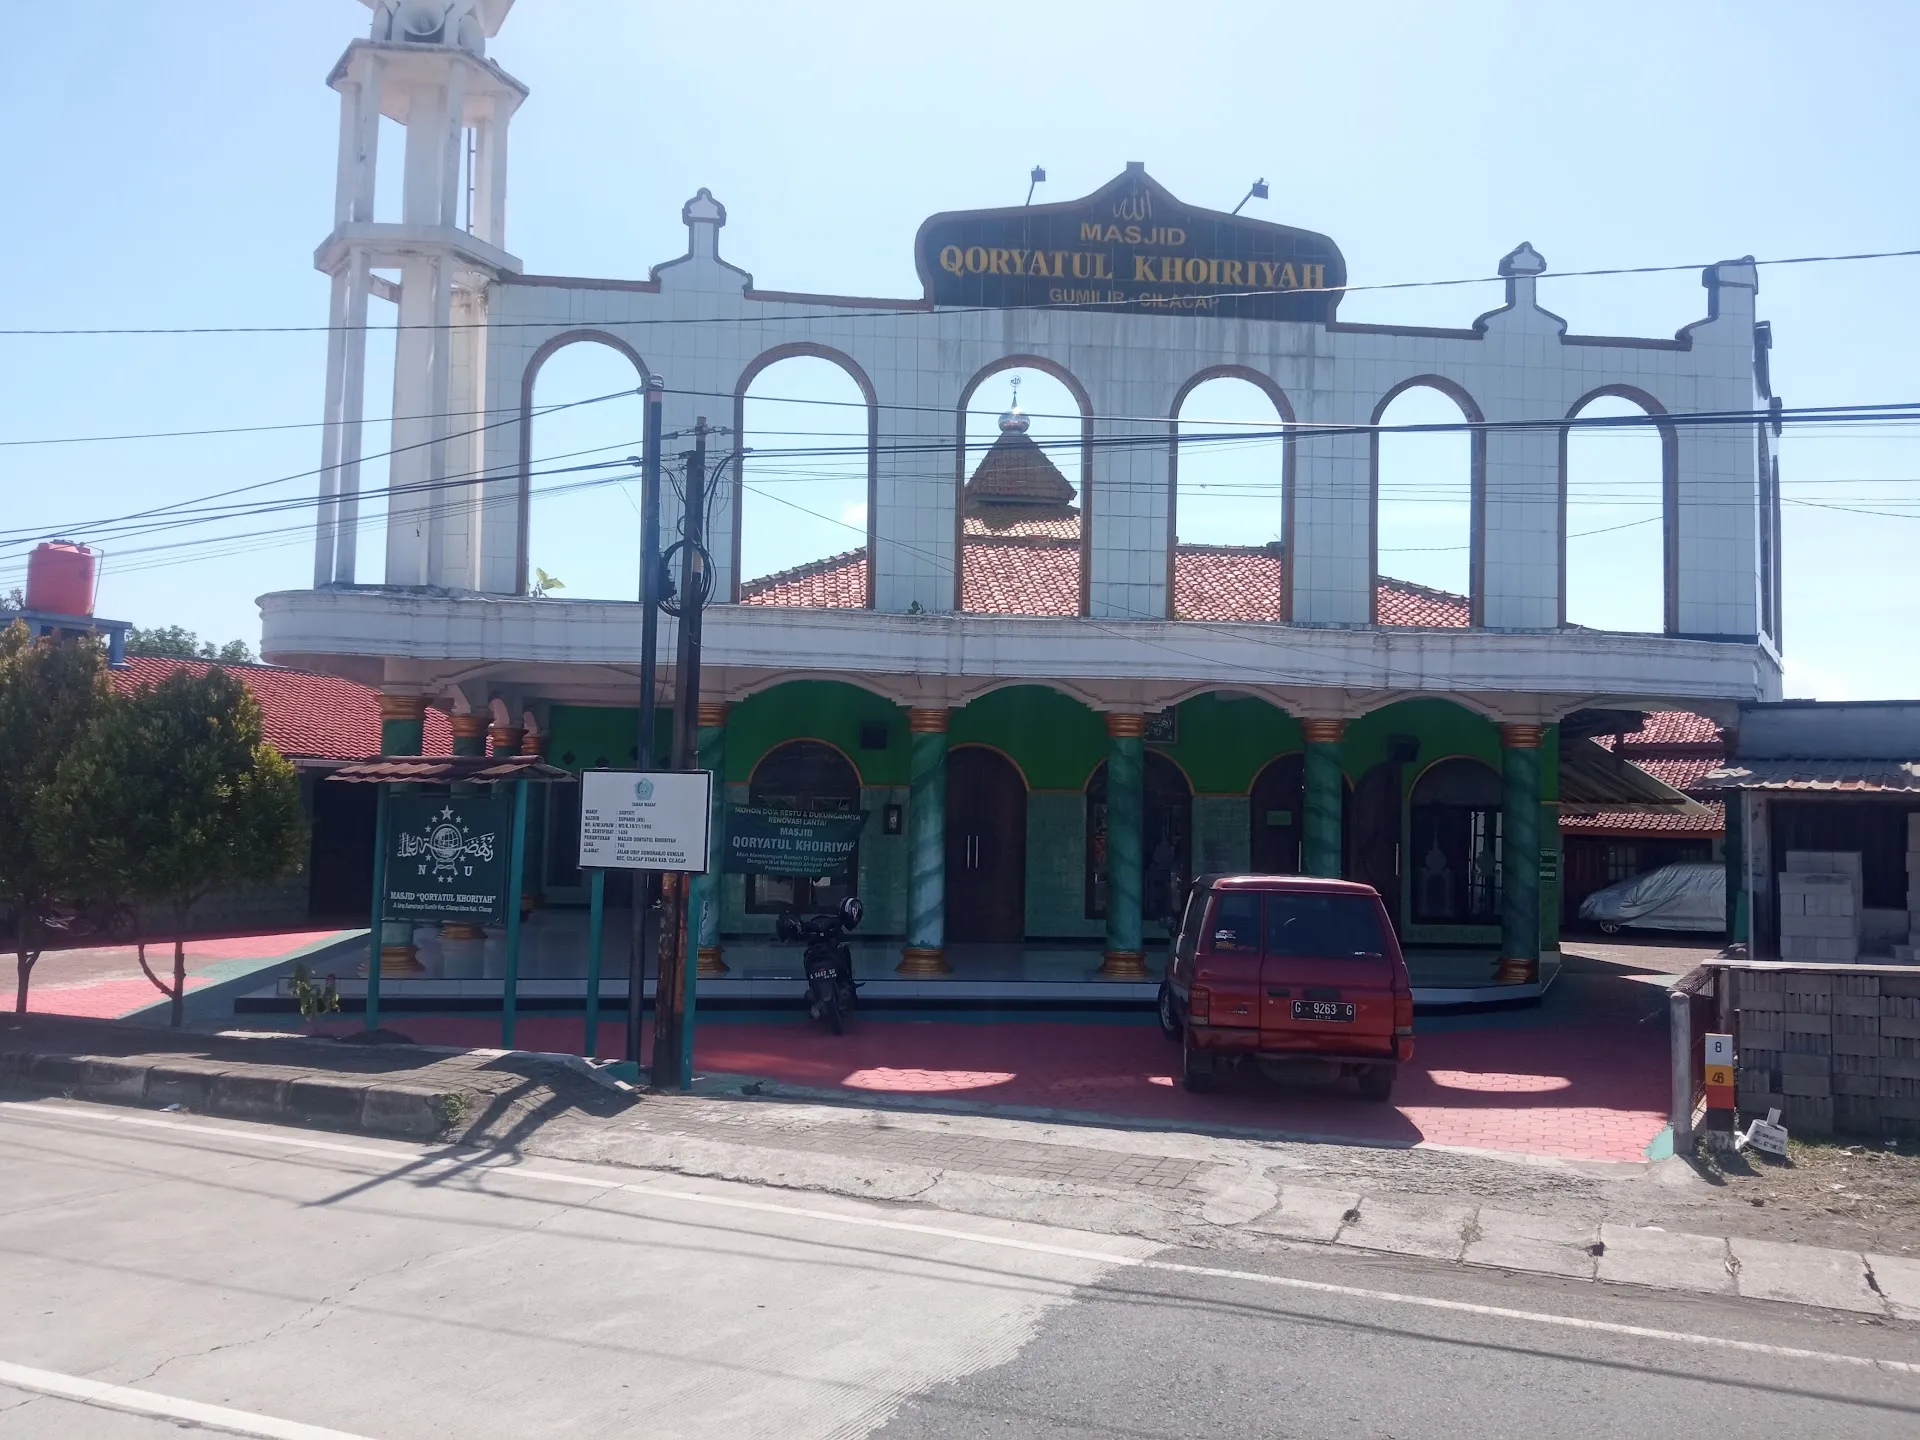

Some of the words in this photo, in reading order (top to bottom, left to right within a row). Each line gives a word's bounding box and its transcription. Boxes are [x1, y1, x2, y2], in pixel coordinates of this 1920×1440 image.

[1080, 223, 1186, 246] MASJID
[939, 245, 1114, 280] QORYATUL
[1134, 255, 1327, 289] KHOIRIYAH
[1050, 288, 1125, 304] GUMILIR
[1139, 292, 1220, 309] CILACAP
[735, 807, 761, 815] MOHON
[763, 808, 778, 816] DO'A
[780, 809, 802, 817] RESTU
[809, 811, 861, 821] DUKUNGANNYA
[768, 816, 802, 825] RENOVASI
[803, 818, 827, 827] LANTAI
[780, 827, 813, 837] MASJID
[732, 836, 792, 850] QORYATUL
[418, 865, 427, 875] N
[464, 866, 473, 876] U
[391, 891, 415, 900] MASJID
[1295, 1001, 1301, 1013] G
[1313, 1002, 1336, 1015] 9263
[1346, 1004, 1353, 1016] G
[1711, 1072, 1724, 1084] 46
